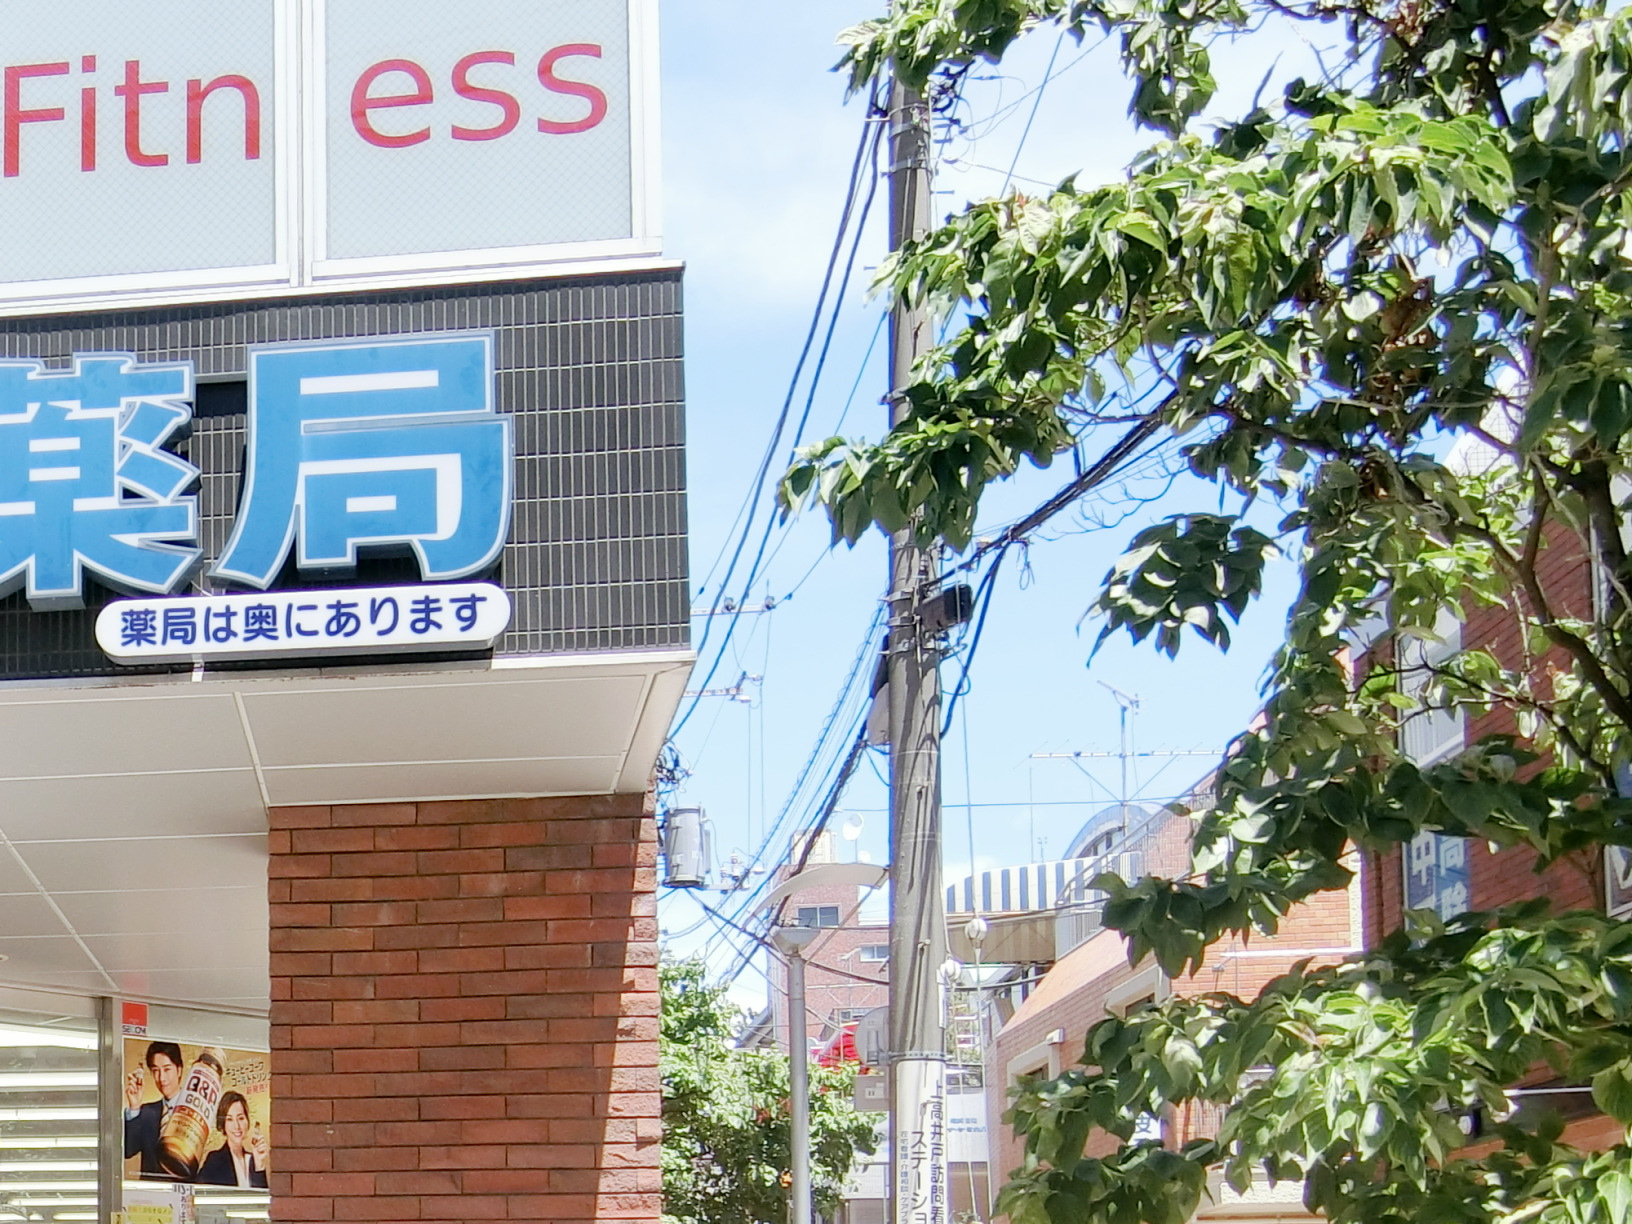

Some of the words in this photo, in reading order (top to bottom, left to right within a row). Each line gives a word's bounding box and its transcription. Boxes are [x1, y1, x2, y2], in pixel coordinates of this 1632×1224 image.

[3, 43, 608, 178] Fitness
[121, 594, 488, 647] 薬局は奥にあります
